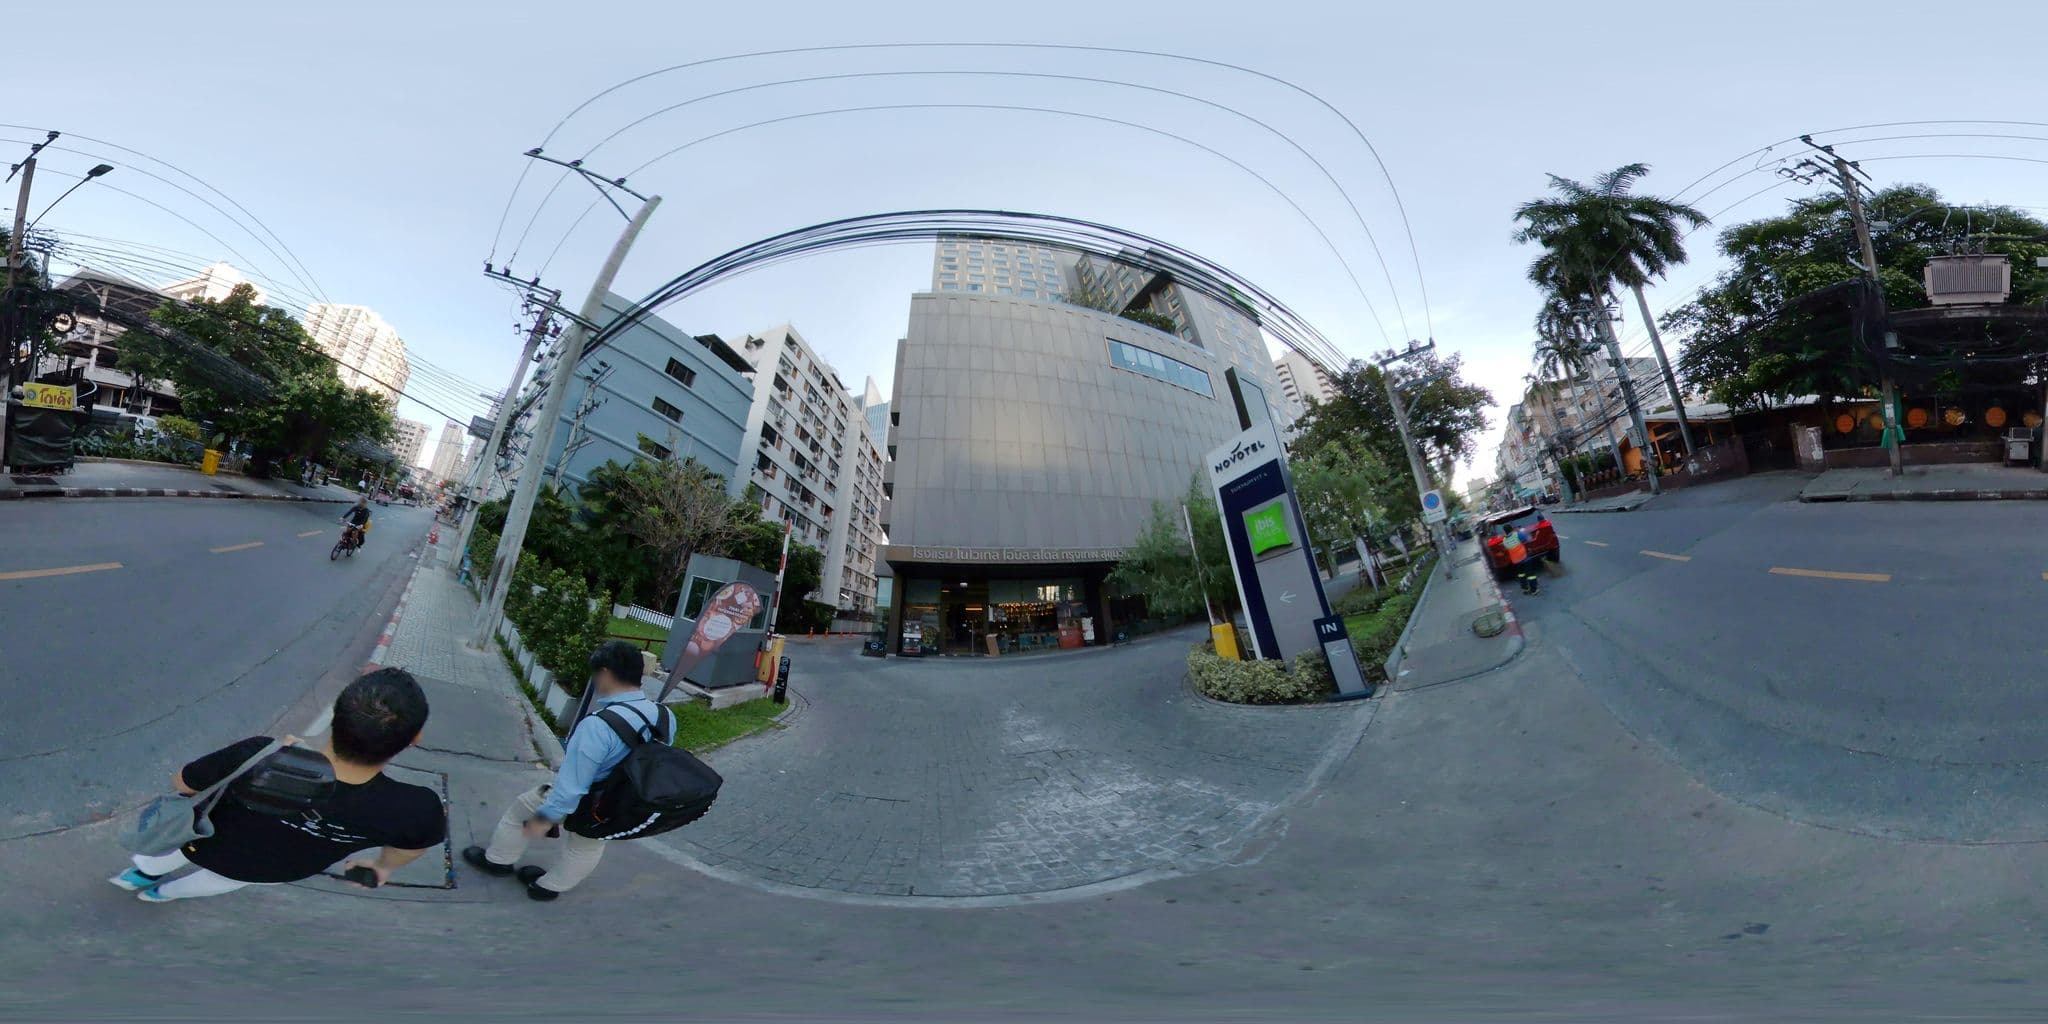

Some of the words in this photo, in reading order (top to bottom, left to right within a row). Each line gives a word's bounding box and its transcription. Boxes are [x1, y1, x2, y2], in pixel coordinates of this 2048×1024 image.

[1215, 440, 1265, 474] NOVOTEL
[1255, 515, 1275, 532] ibis
[1320, 622, 1338, 634] IN
